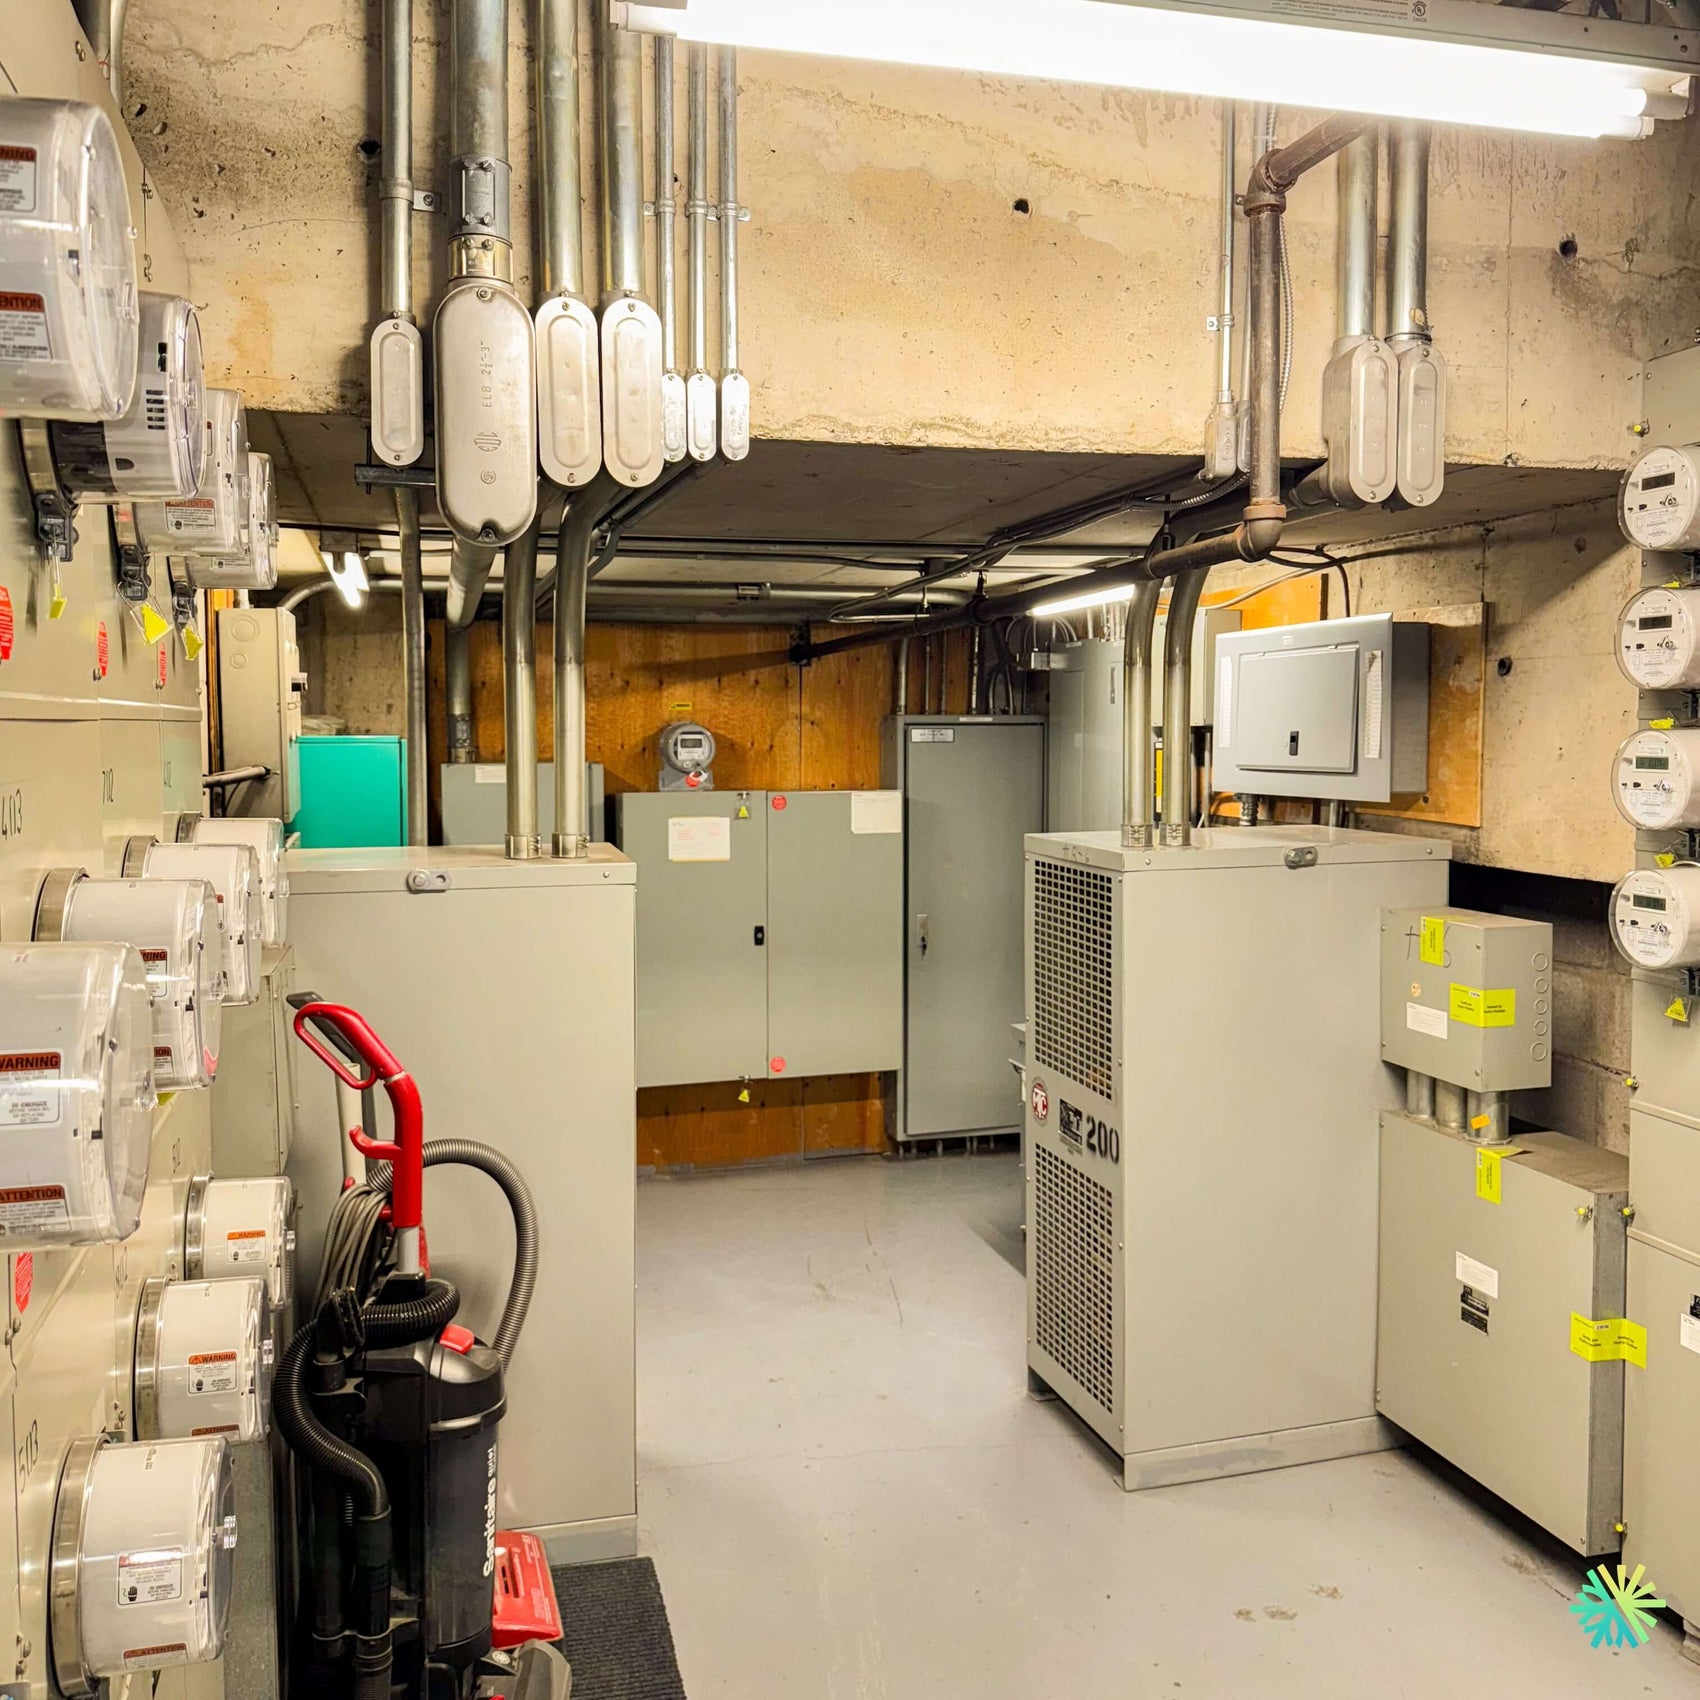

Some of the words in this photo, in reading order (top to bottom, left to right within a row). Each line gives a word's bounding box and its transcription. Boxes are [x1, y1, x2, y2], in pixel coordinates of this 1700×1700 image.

[481, 385, 493, 408] ELB
[1, 788, 23, 840] 403
[1086, 1115, 1120, 1164] 200
[202, 1354, 236, 1363] WARNING
[483, 1477, 496, 1577] Sanitaire
[140, 1644, 184, 1655] ATTENTION
